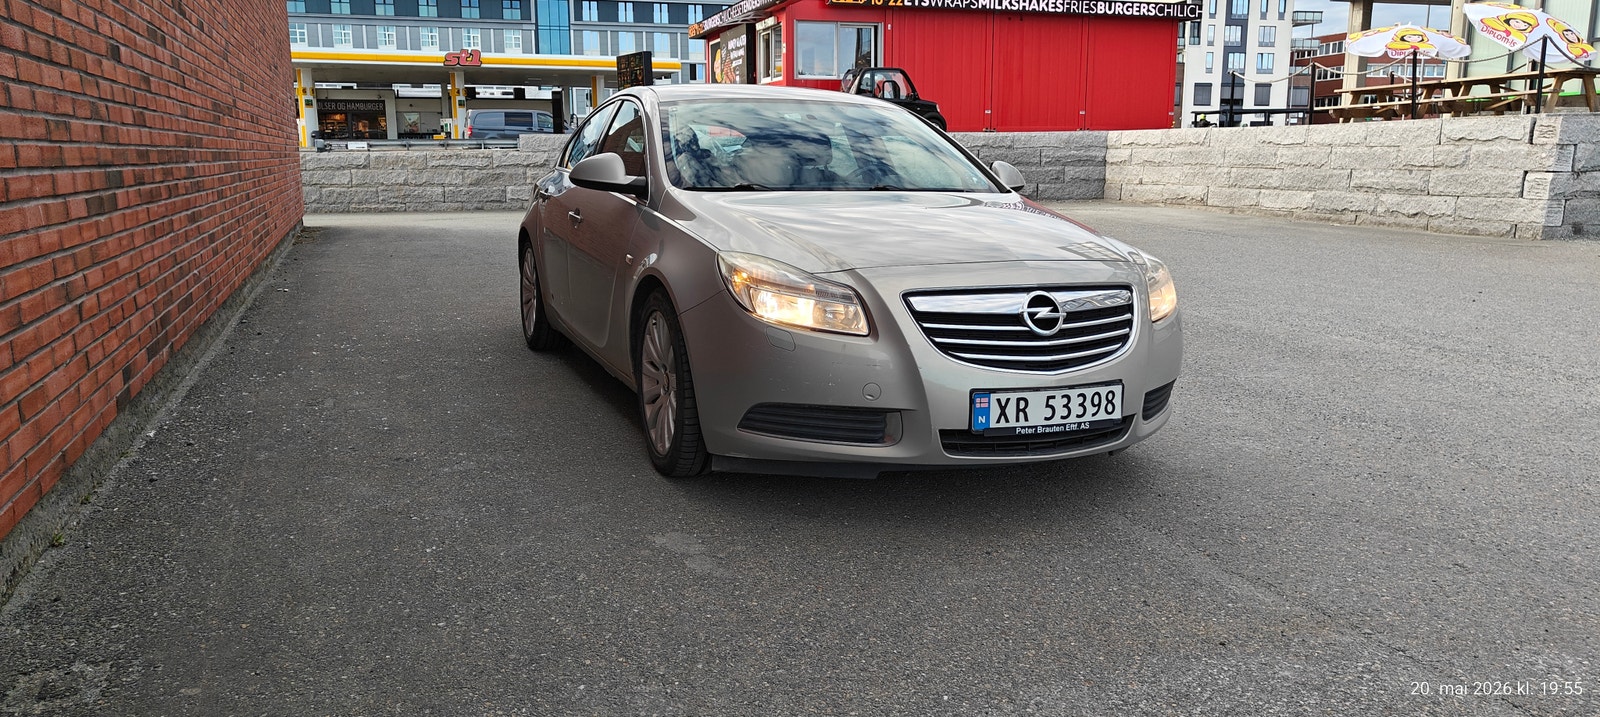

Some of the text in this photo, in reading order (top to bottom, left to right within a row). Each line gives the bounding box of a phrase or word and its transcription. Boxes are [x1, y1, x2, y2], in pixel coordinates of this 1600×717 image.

[346, 102, 383, 111] HAMBURGER
[995, 397, 1029, 424] XR
[1043, 390, 1116, 421] 53398
[1037, 425, 1064, 433] Brauten
[1065, 423, 1080, 431] Eftf.
